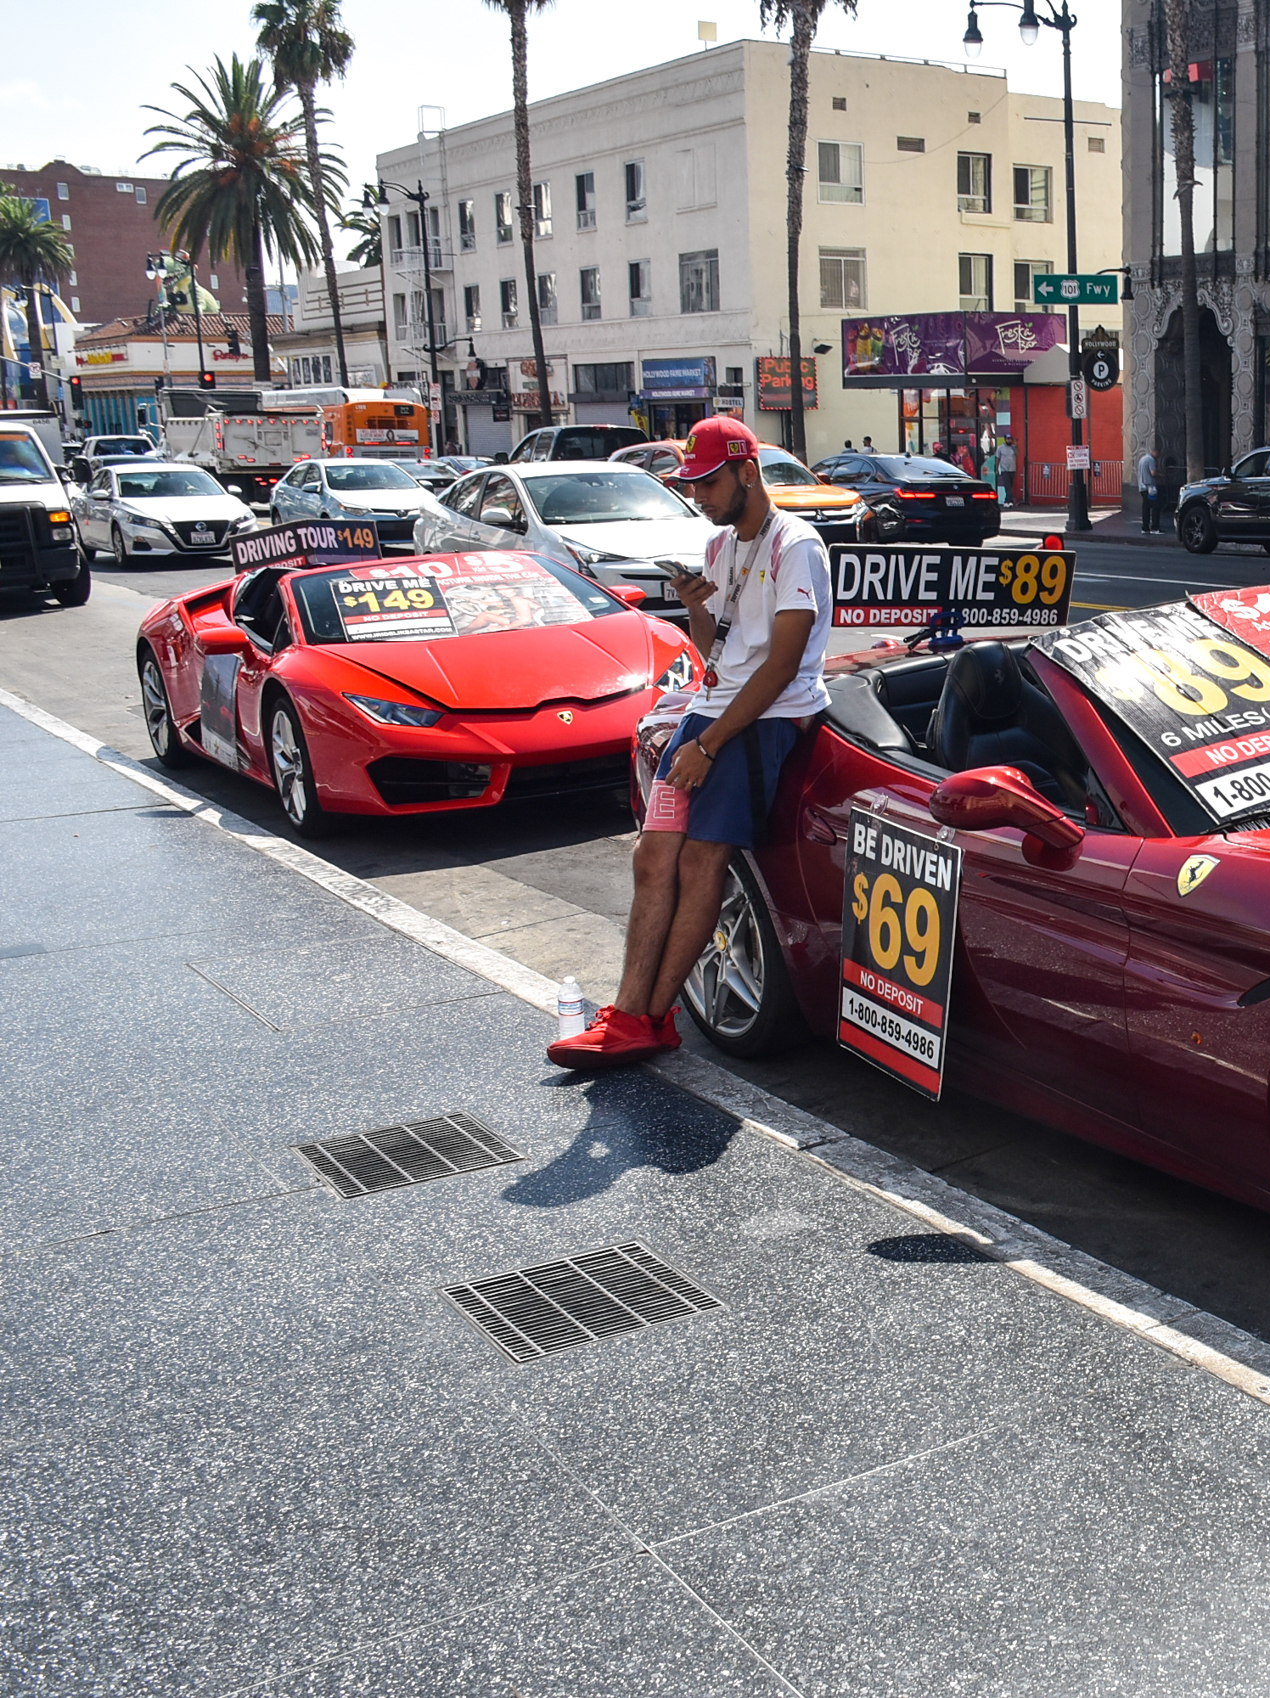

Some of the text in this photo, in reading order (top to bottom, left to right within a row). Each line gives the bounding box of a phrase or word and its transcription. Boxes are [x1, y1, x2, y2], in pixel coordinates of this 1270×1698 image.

[1064, 283, 1111, 297] 101 Fwy
[643, 370, 669, 379] HOLLYWOOD
[682, 368, 701, 377] MARKET
[1091, 379, 1112, 387] PARKING
[236, 529, 297, 565] DRIVING
[297, 526, 339, 550] TOUR
[337, 527, 375, 549] $149
[339, 577, 432, 594] DRIVE ME
[836, 553, 1067, 605] DRIVE ME $89
[344, 589, 435, 613] $149
[382, 611, 429, 620] DEPOSIT
[839, 608, 865, 624] NO
[869, 608, 938, 624] DEPOSIT
[1160, 710, 1266, 747] 6 MILES
[1205, 741, 1239, 765] NO
[853, 822, 952, 892] BE DRIVEN
[851, 871, 940, 987] $69
[860, 970, 924, 1016] NO DEPOSIT
[848, 997, 935, 1060] 1-800-859-4986
